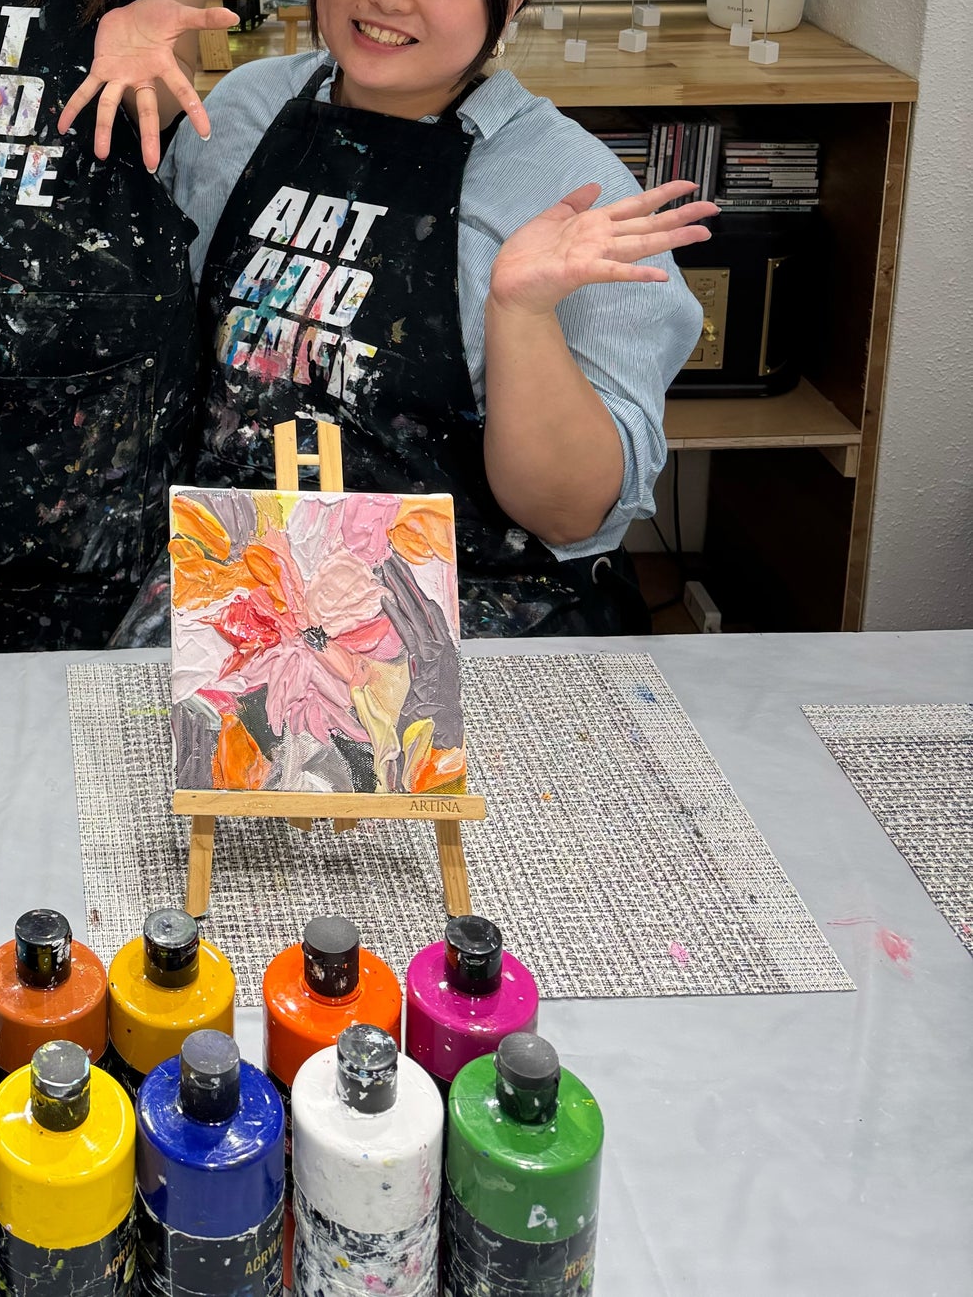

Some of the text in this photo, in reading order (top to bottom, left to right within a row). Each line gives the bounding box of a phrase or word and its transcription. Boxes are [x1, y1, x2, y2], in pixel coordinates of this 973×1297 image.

[248, 185, 389, 261] ART
[229, 247, 374, 327] AND
[410, 800, 462, 813] ARTINA
